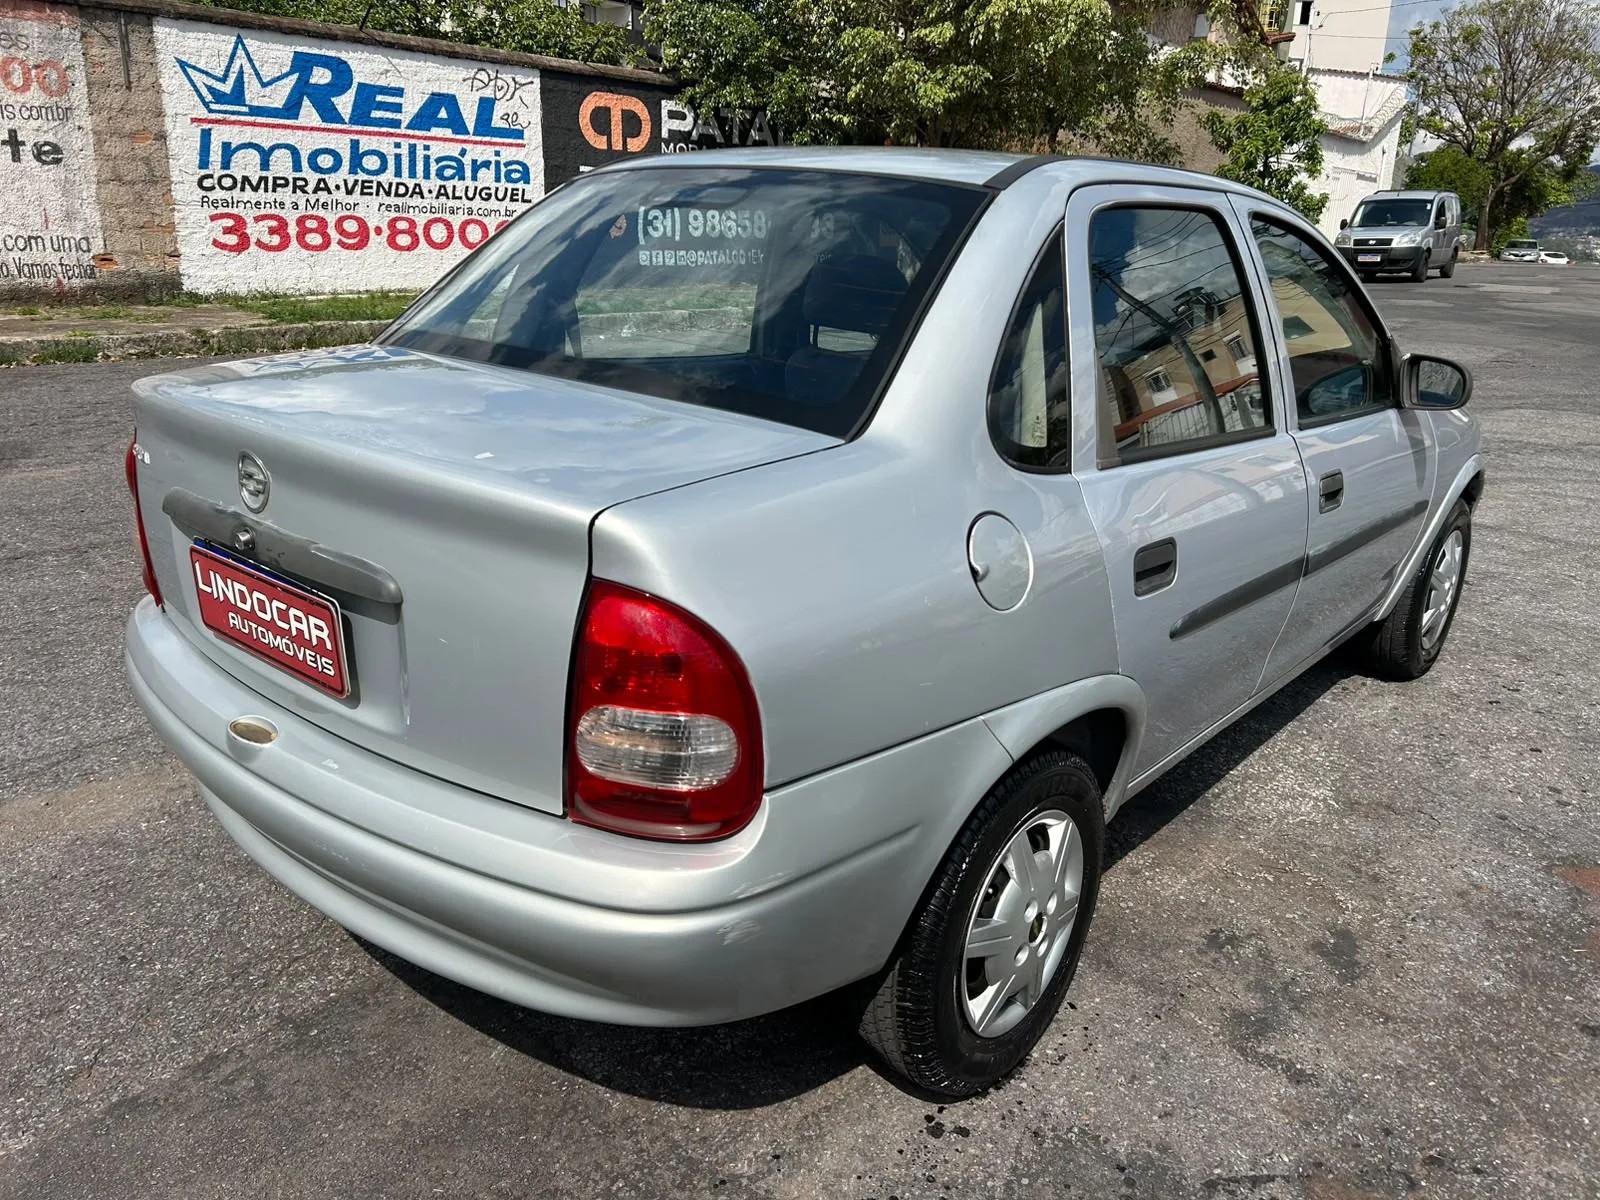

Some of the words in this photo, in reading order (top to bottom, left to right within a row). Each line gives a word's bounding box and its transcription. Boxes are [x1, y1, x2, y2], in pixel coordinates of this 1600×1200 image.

[283, 51, 524, 140] REAL
[197, 128, 531, 185] Imobiliária
[200, 195, 286, 211] Realmente
[291, 201, 299, 211] a
[305, 198, 360, 212] Melhor
[3, 234, 46, 252] com
[50, 234, 92, 253] uma
[195, 561, 332, 651] LINDOCAR
[228, 611, 335, 677] AUTOMÓVEIS
